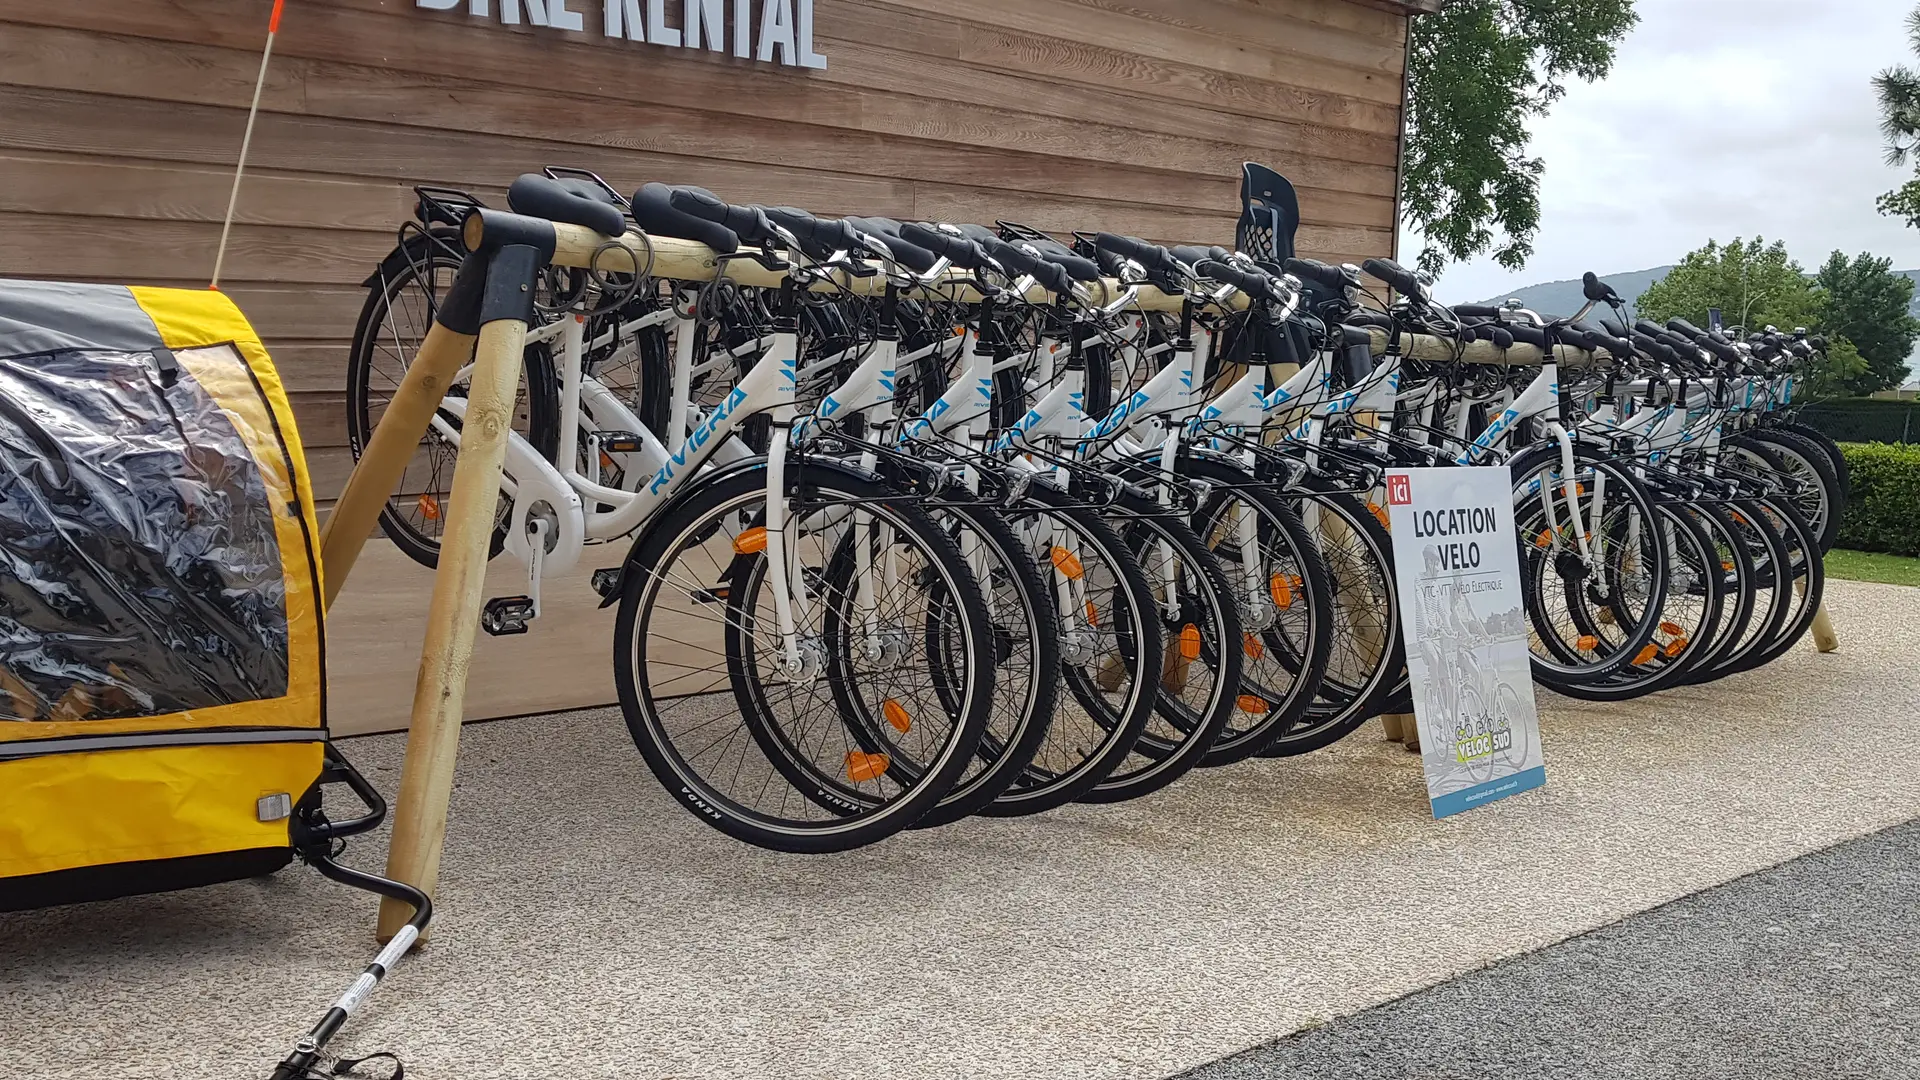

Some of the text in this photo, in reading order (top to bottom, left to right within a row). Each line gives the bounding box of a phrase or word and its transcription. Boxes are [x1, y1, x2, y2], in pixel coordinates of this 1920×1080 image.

[650, 387, 748, 496] RIVIERA
[1392, 477, 1408, 502] ici
[1413, 507, 1497, 538] LOCATION
[1437, 541, 1481, 571] VELO
[1457, 730, 1511, 761] VELOC SUD
[681, 786, 722, 820] KENDA
[817, 789, 859, 811] KENDA
